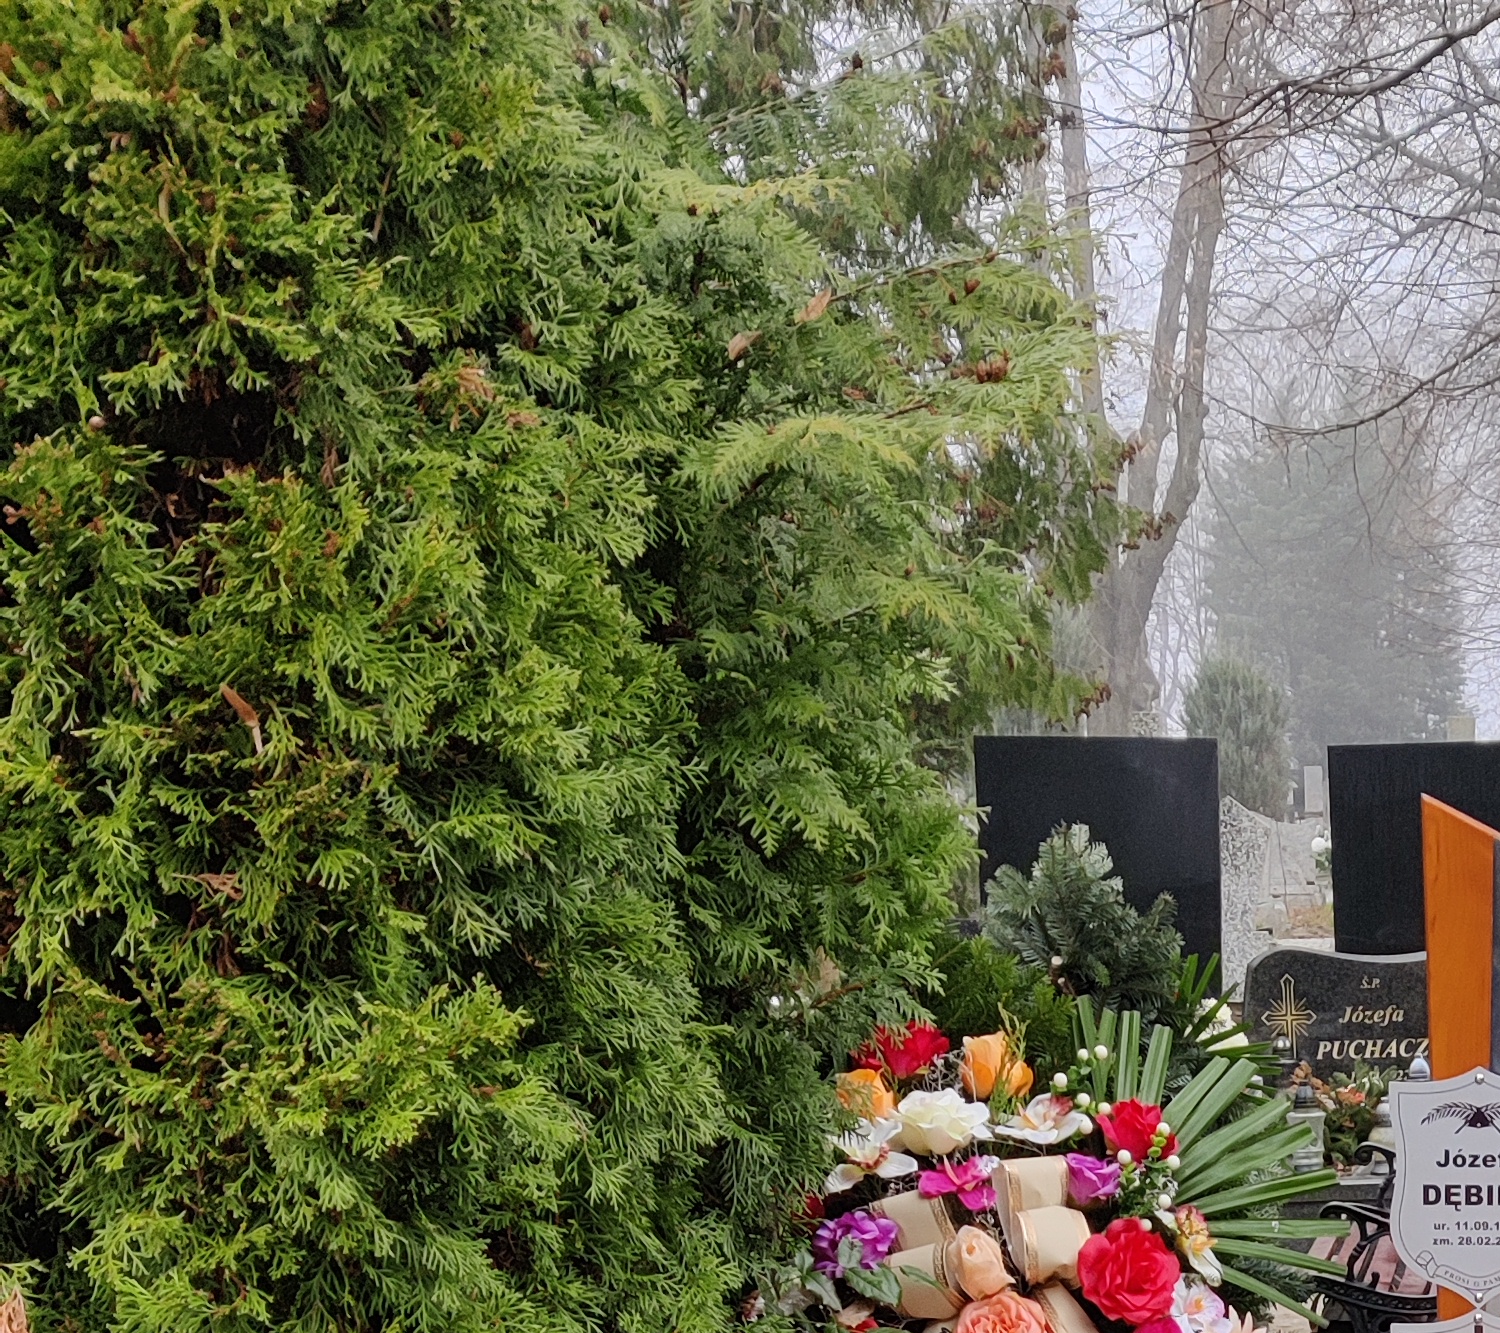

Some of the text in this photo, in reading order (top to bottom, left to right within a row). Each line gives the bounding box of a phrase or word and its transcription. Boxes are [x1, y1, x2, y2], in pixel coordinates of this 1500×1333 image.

[1338, 1005, 1404, 1027] Józefa
[1316, 1037, 1430, 1061] PUCHACZ
[1433, 1222, 1450, 1231] ur.
[1432, 1238, 1454, 1246] zm.
